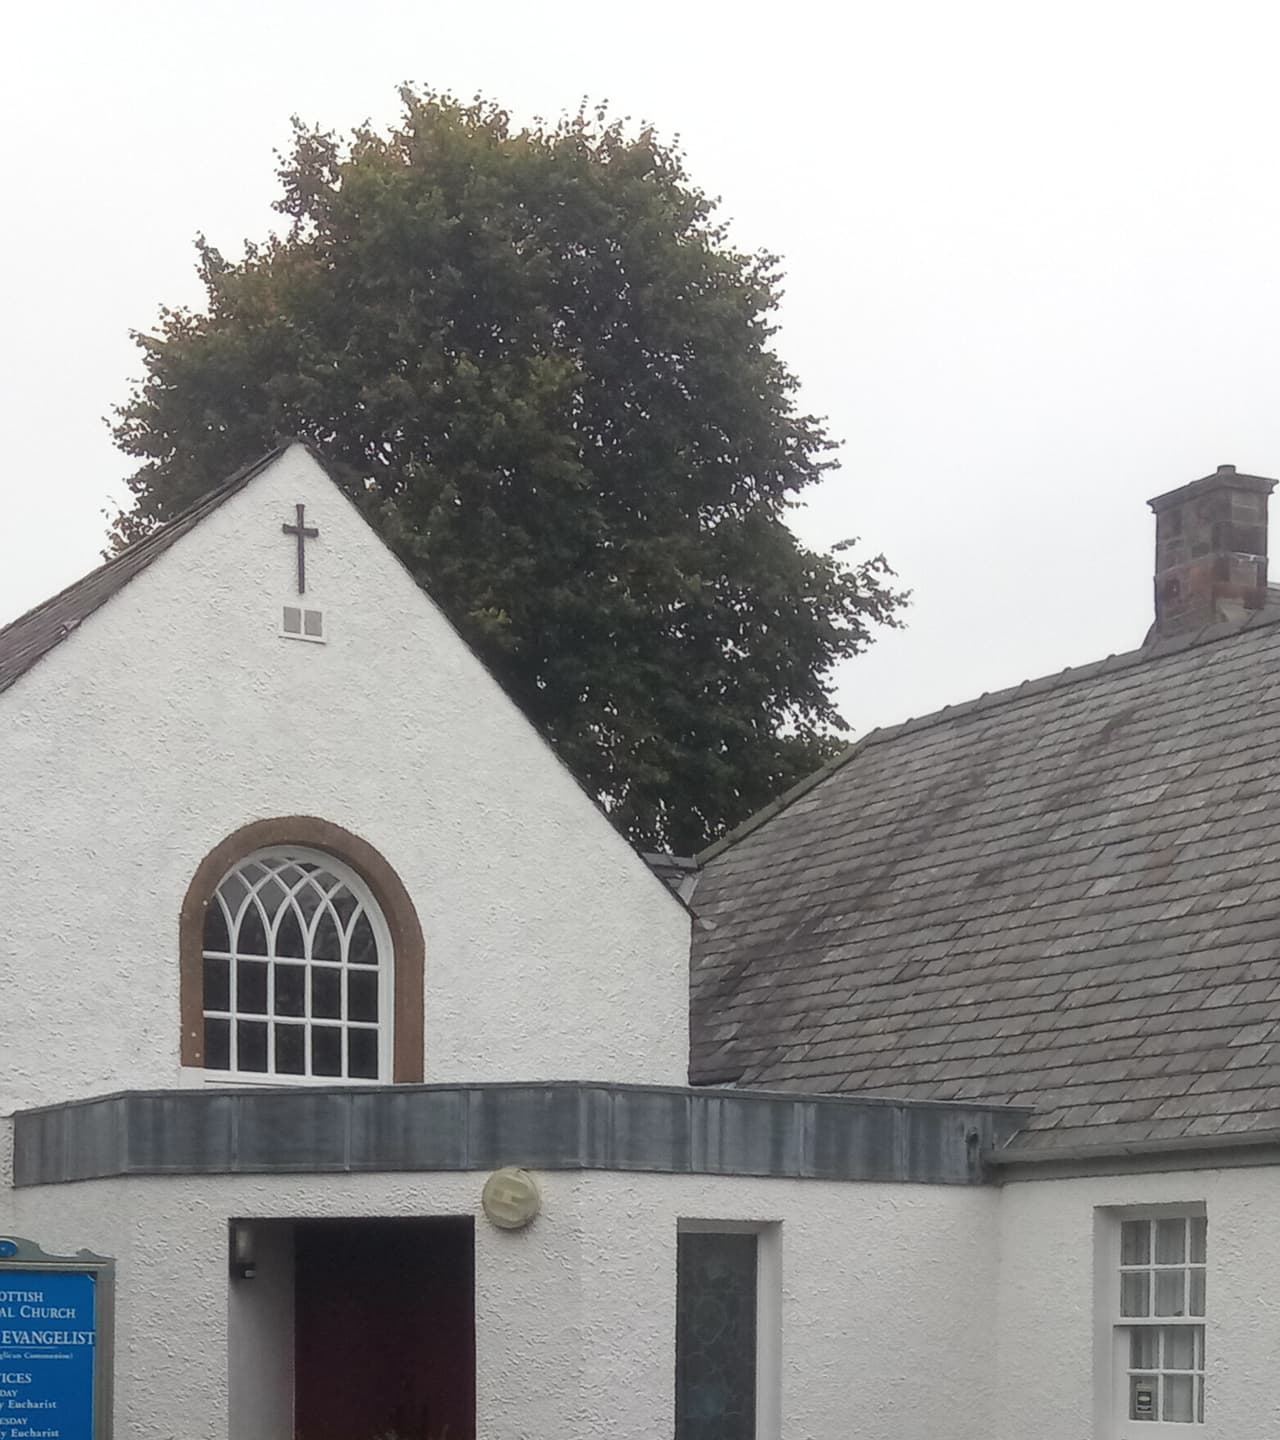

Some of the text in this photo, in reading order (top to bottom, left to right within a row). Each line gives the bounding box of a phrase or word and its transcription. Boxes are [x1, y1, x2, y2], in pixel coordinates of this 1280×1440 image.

[20, 1305, 76, 1319] CHURCH
[1, 1330, 95, 1345] EVANGELIST
[8, 1399, 57, 1409] Eucharist
[11, 1428, 59, 1438] Eucharist
